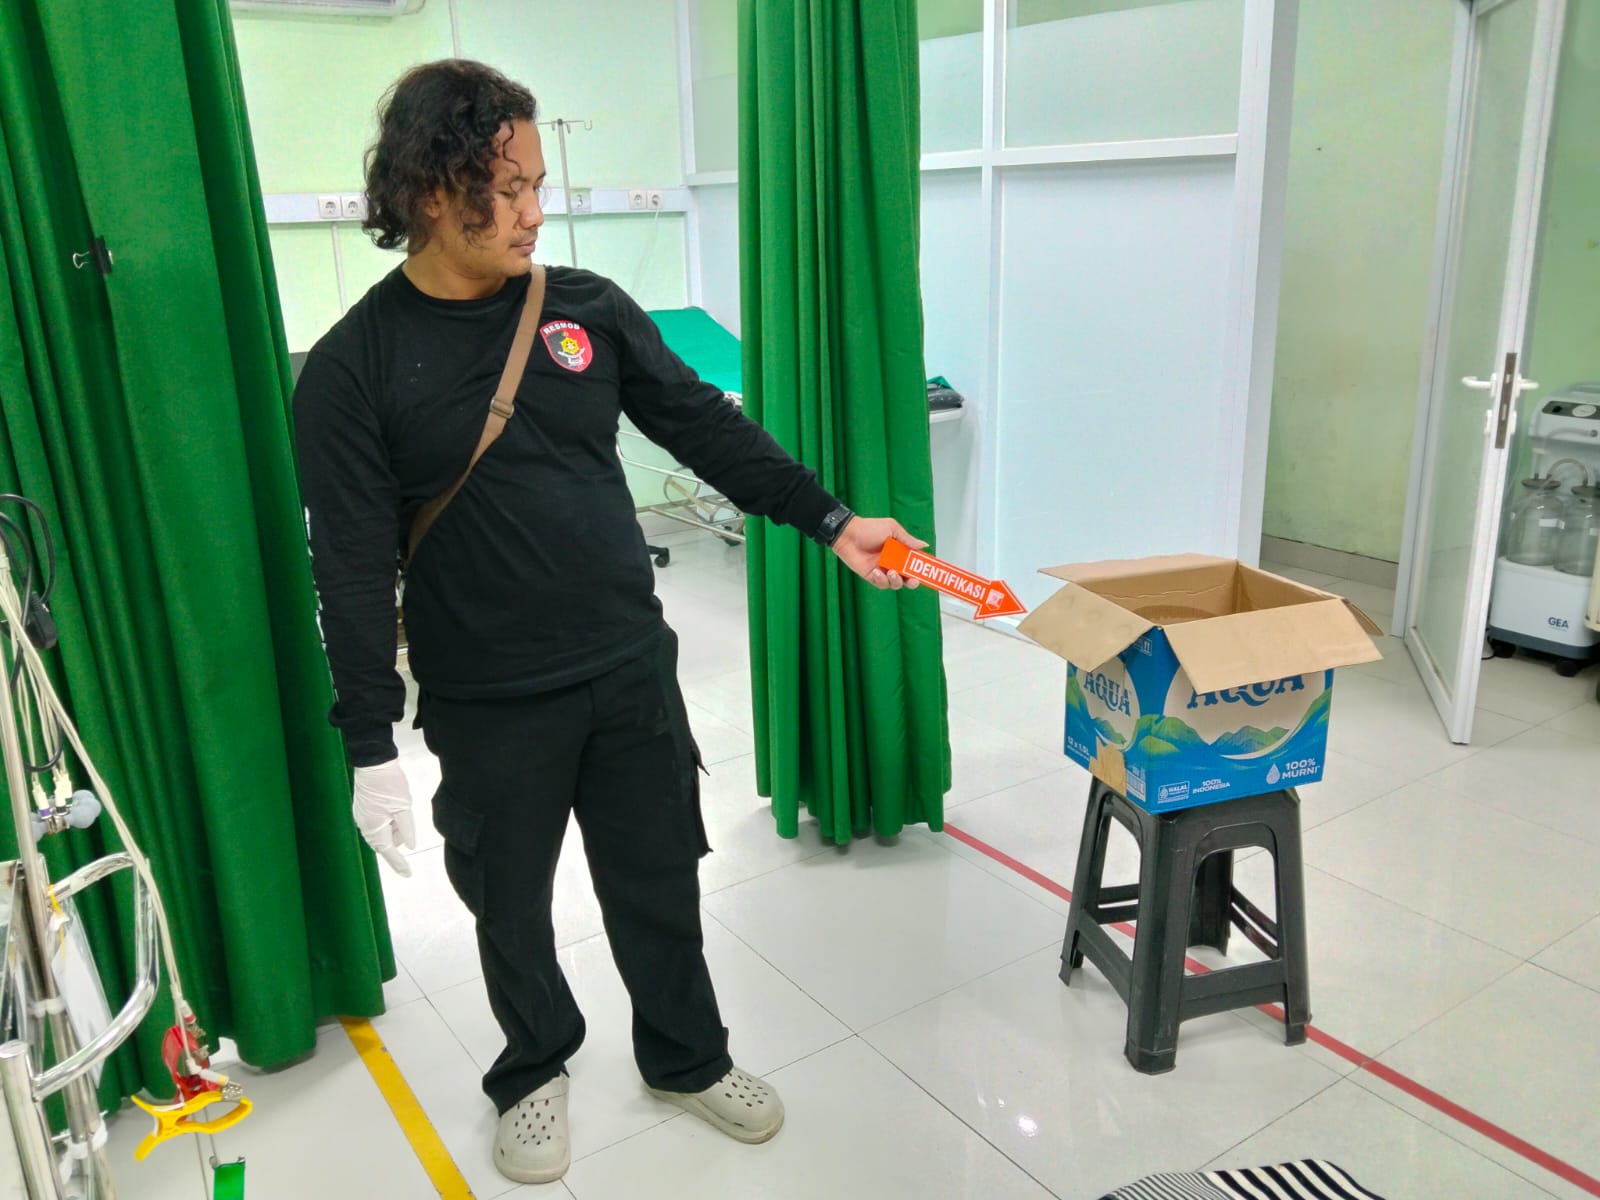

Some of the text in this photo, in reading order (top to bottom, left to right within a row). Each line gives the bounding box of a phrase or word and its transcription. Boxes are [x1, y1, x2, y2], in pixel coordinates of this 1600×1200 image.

[576, 194, 584, 208] 3
[909, 557, 986, 600] IDENTIFIKASI
[1548, 616, 1568, 629] GEA
[1083, 670, 1131, 717] AQUA
[1285, 757, 1316, 770] 100%
[1281, 766, 1318, 780] MURNI
[1192, 782, 1231, 793] INDONESIA
[1202, 779, 1222, 787] 100%
